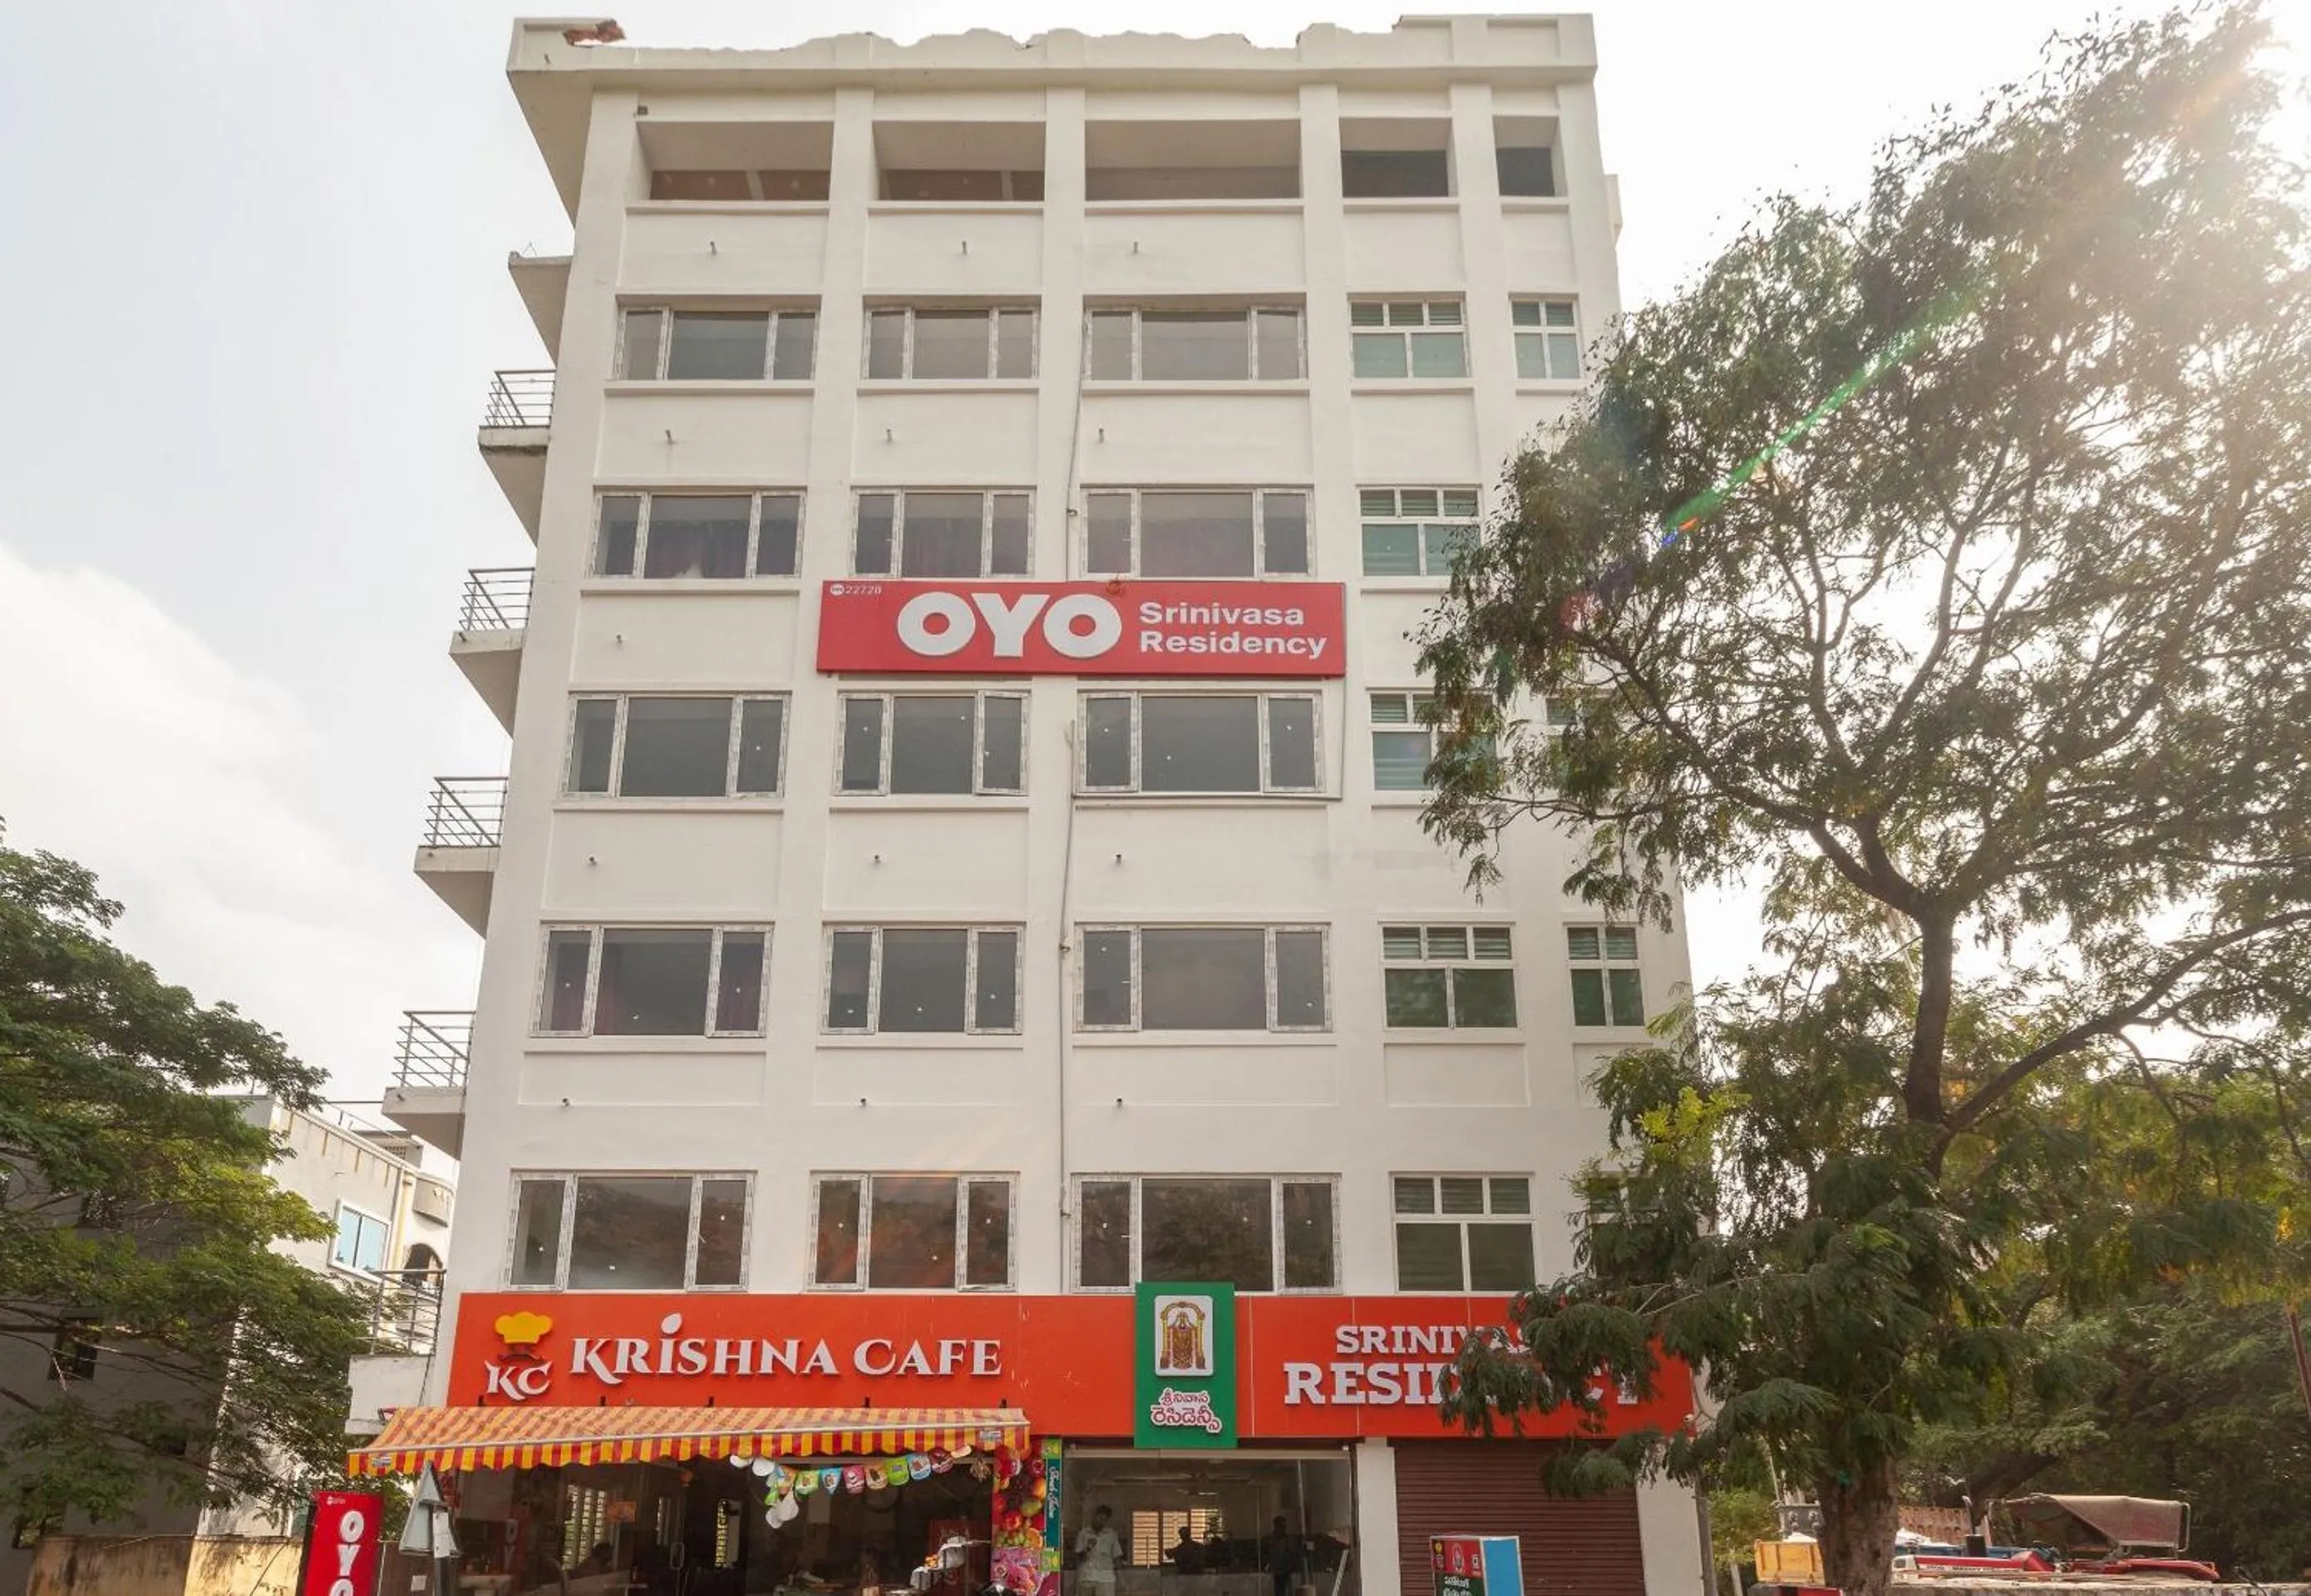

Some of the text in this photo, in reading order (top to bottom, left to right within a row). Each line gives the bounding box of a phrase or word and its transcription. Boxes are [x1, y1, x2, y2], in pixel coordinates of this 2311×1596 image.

[897, 592, 1122, 658] OYO
[1140, 601, 1304, 625] Srinivasa
[1140, 630, 1328, 659] Residency
[569, 1313, 1002, 1385] KRISHNA CAFE
[485, 1361, 553, 1401] KC
[328, 1510, 365, 1596] OYO
